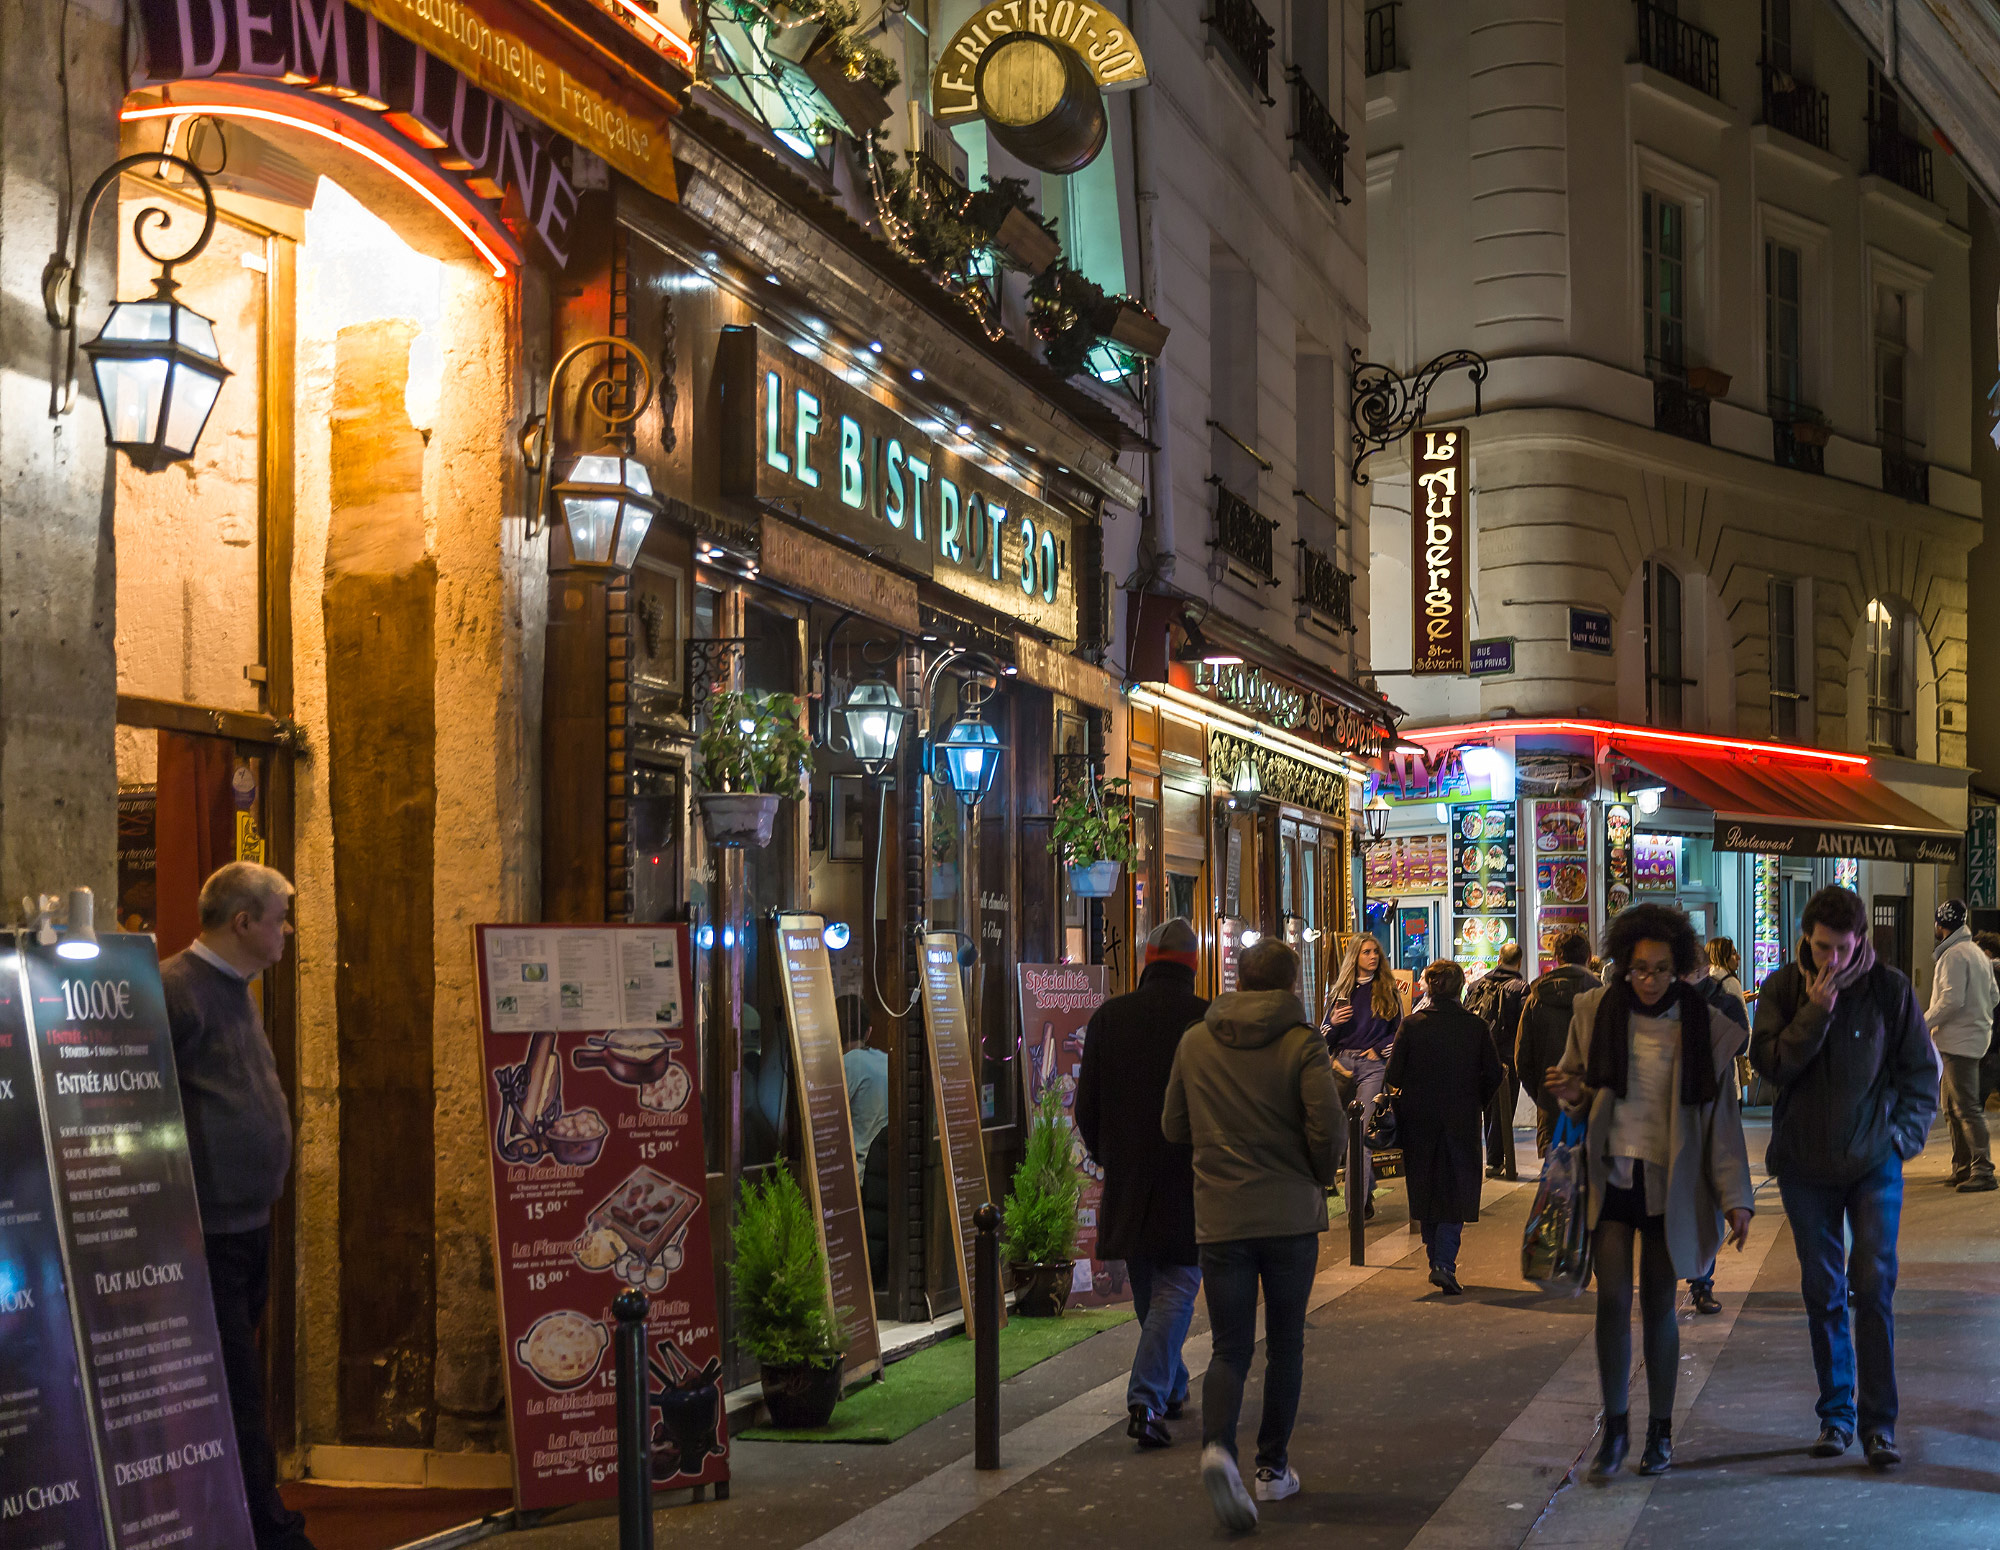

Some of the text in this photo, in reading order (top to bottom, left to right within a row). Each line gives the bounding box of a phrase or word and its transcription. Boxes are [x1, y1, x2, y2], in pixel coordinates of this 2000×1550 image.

[560, 68, 650, 161] Française
[177, 0, 578, 270] DEMI LUNE
[766, 370, 821, 488] LE
[840, 414, 1007, 582] BISTROT
[1418, 432, 1457, 642] L'Auberge
[1415, 656, 1462, 671] Séverin
[1477, 646, 1491, 657] RUE
[1484, 656, 1507, 668] PRIVAS
[1725, 825, 1956, 861] Restaurant ANTALYA Grillades
[1969, 808, 1984, 907] PIZZA
[1025, 969, 1089, 994] Spécialités
[61, 978, 133, 1021] 10.00€
[1036, 988, 1105, 1013] Savoyardes
[56, 1069, 162, 1095] ENTRÉE AU CHOIX
[618, 1112, 637, 1128] La
[507, 1166, 526, 1182] La
[512, 1242, 531, 1259] La
[95, 1262, 184, 1295] PLAT AU CHOIX
[527, 1399, 545, 1416] La
[548, 1433, 567, 1450] La
[114, 1438, 224, 1486] DESSERT AU CHOIX
[2, 1480, 81, 1519] AU CHOIX
